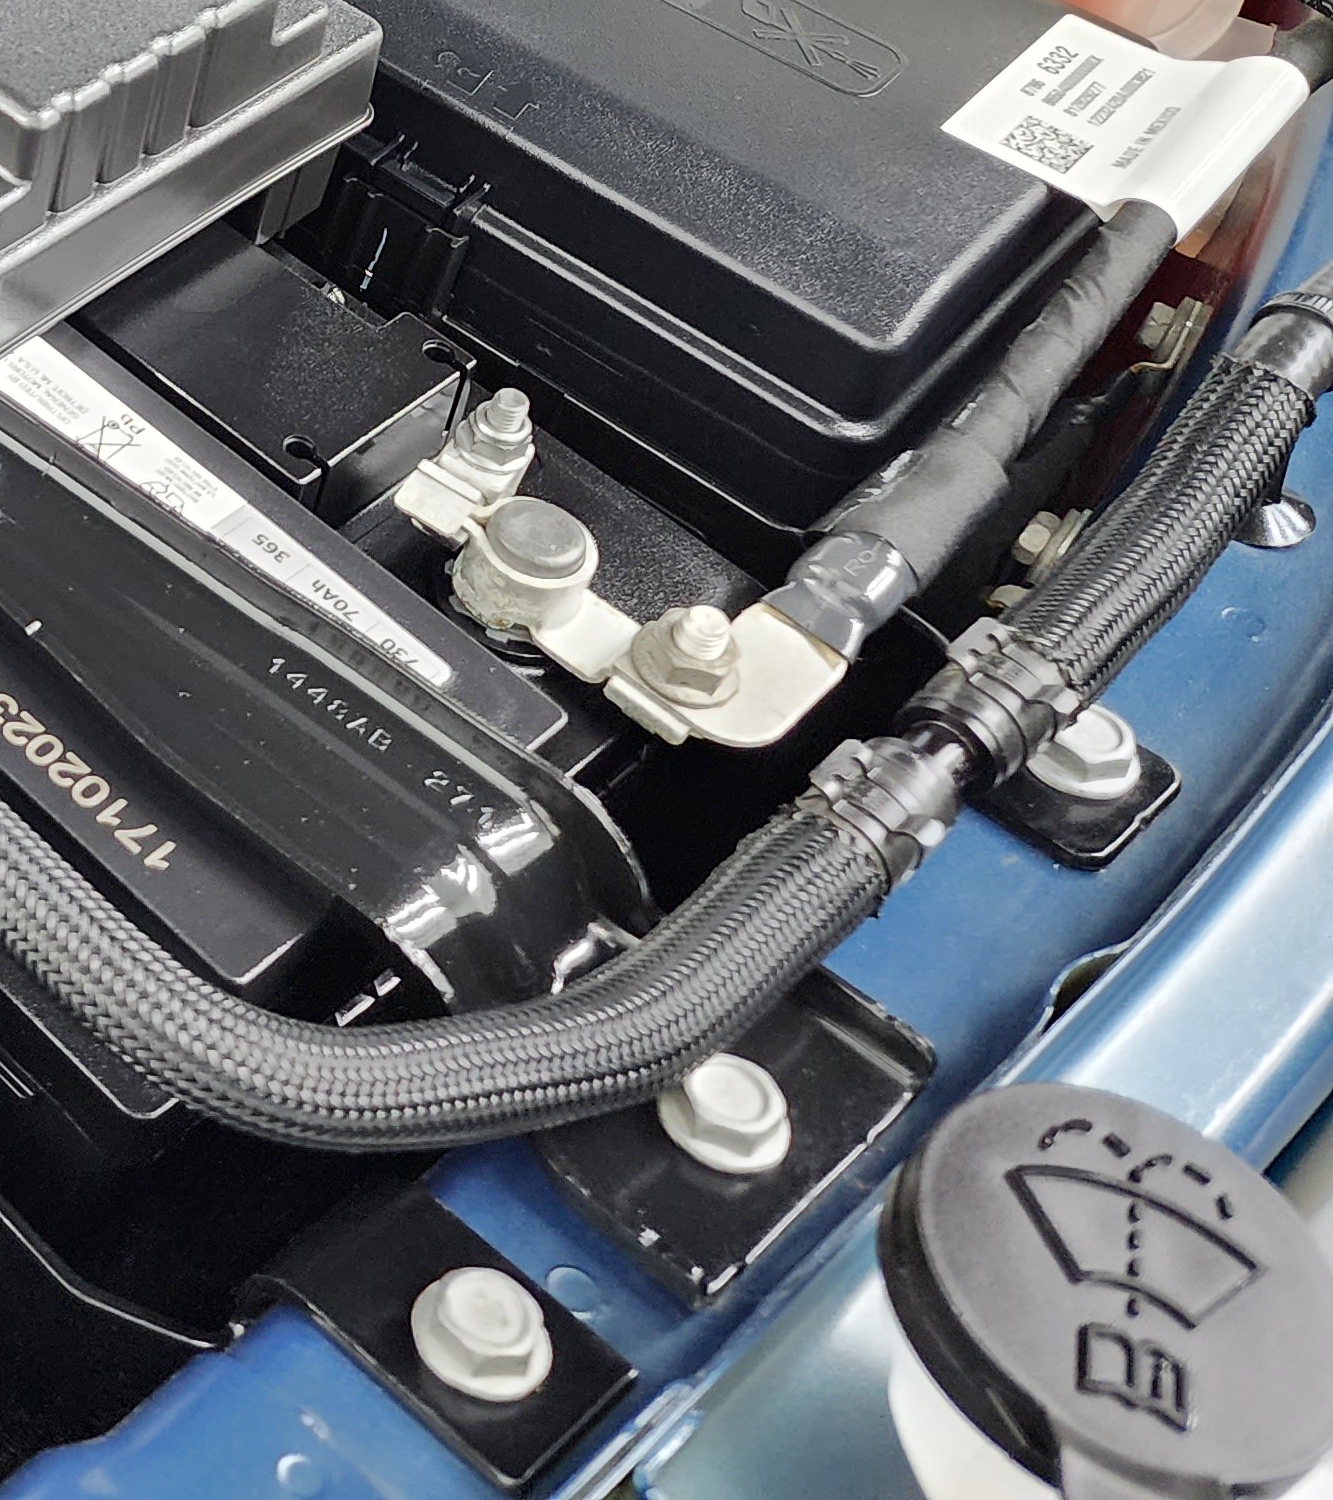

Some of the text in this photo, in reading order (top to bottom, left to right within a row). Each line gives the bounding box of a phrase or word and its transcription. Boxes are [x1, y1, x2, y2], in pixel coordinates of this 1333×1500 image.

[1035, 44, 1080, 77] 6332
[116, 411, 148, 437] Pb
[249, 529, 292, 565] 365
[307, 576, 360, 622] 70Ah
